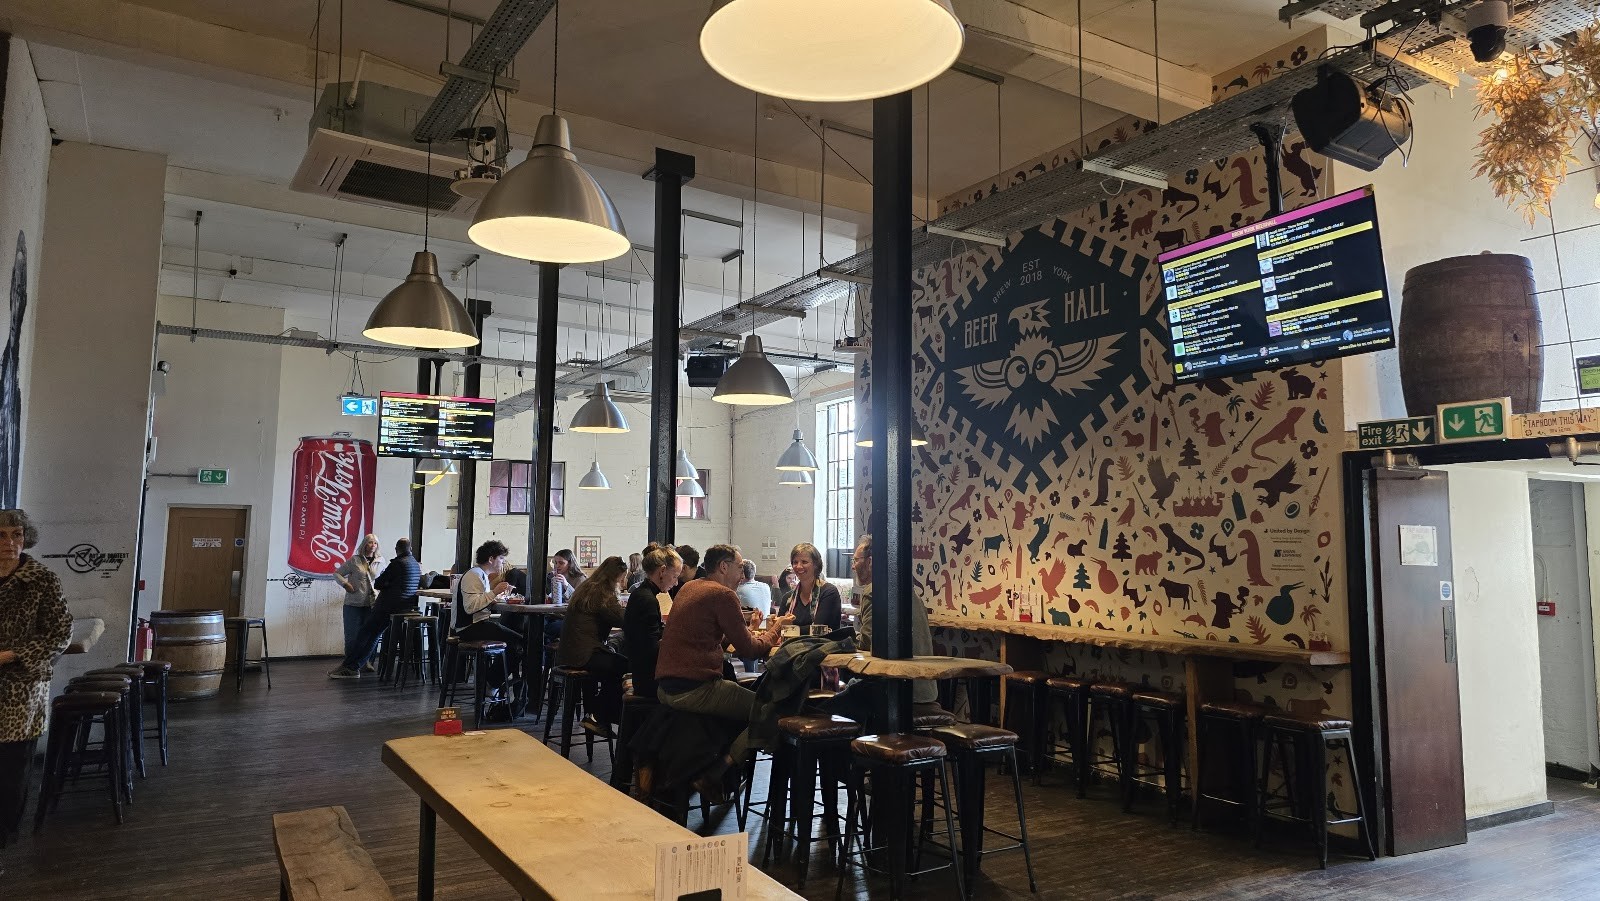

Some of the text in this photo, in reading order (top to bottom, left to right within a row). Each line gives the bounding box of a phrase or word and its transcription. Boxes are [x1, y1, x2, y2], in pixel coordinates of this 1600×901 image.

[1022, 259, 1040, 273] EST
[992, 265, 1073, 304] BREW YORK
[1019, 271, 1042, 286] 2018
[964, 283, 1109, 348] BEER HALL
[1527, 415, 1592, 428] TAPROOM THIS WAY
[1361, 426, 1382, 436] Fire
[1361, 436, 1382, 446] exit
